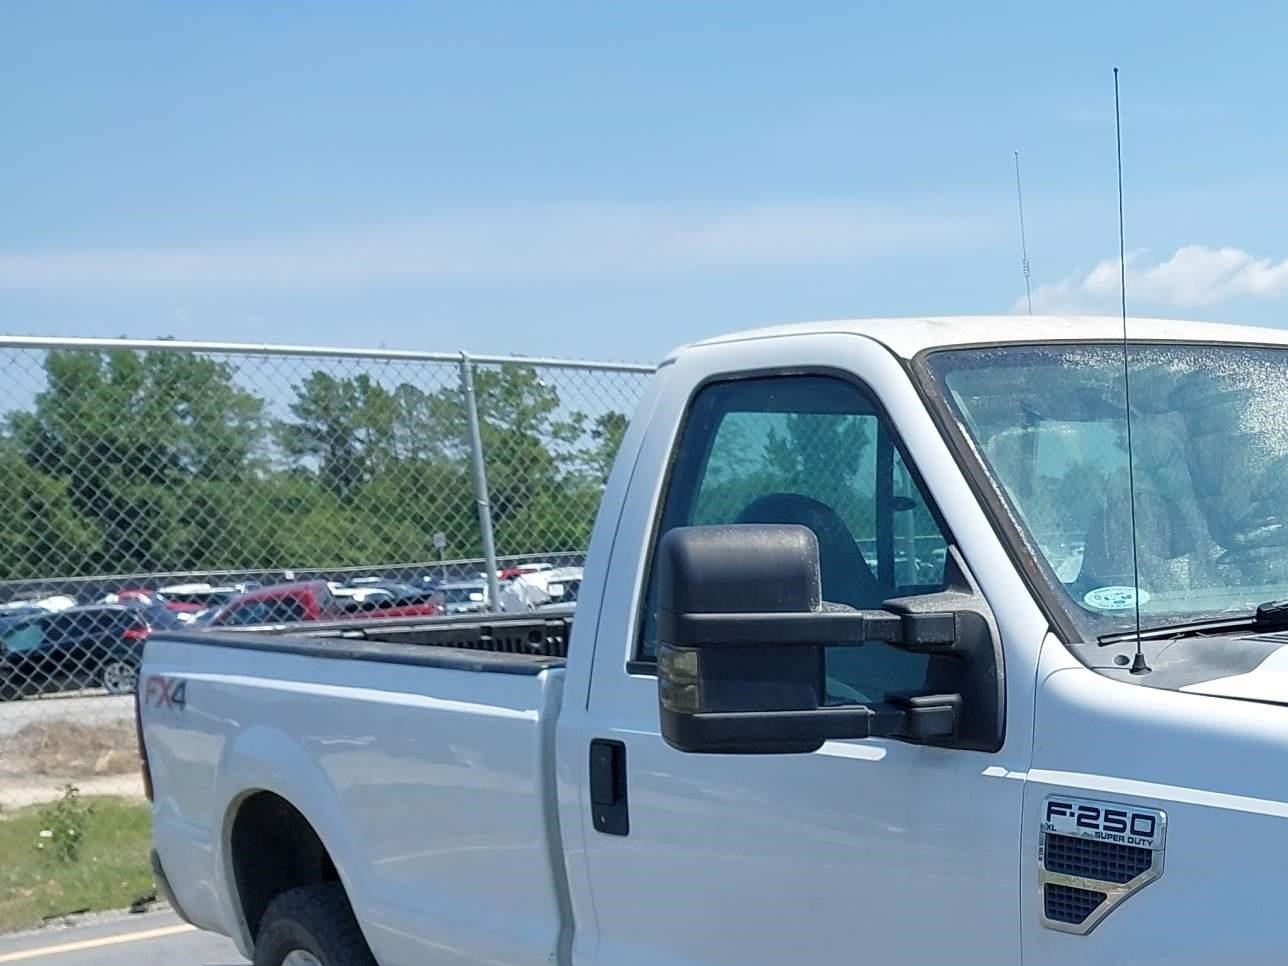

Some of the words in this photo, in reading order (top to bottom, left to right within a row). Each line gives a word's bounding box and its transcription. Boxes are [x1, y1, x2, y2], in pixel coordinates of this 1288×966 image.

[144, 676, 187, 711] FX4
[1047, 801, 1156, 838] F-250
[1095, 831, 1125, 843] SUPER
[1127, 836, 1154, 846] DUTY
